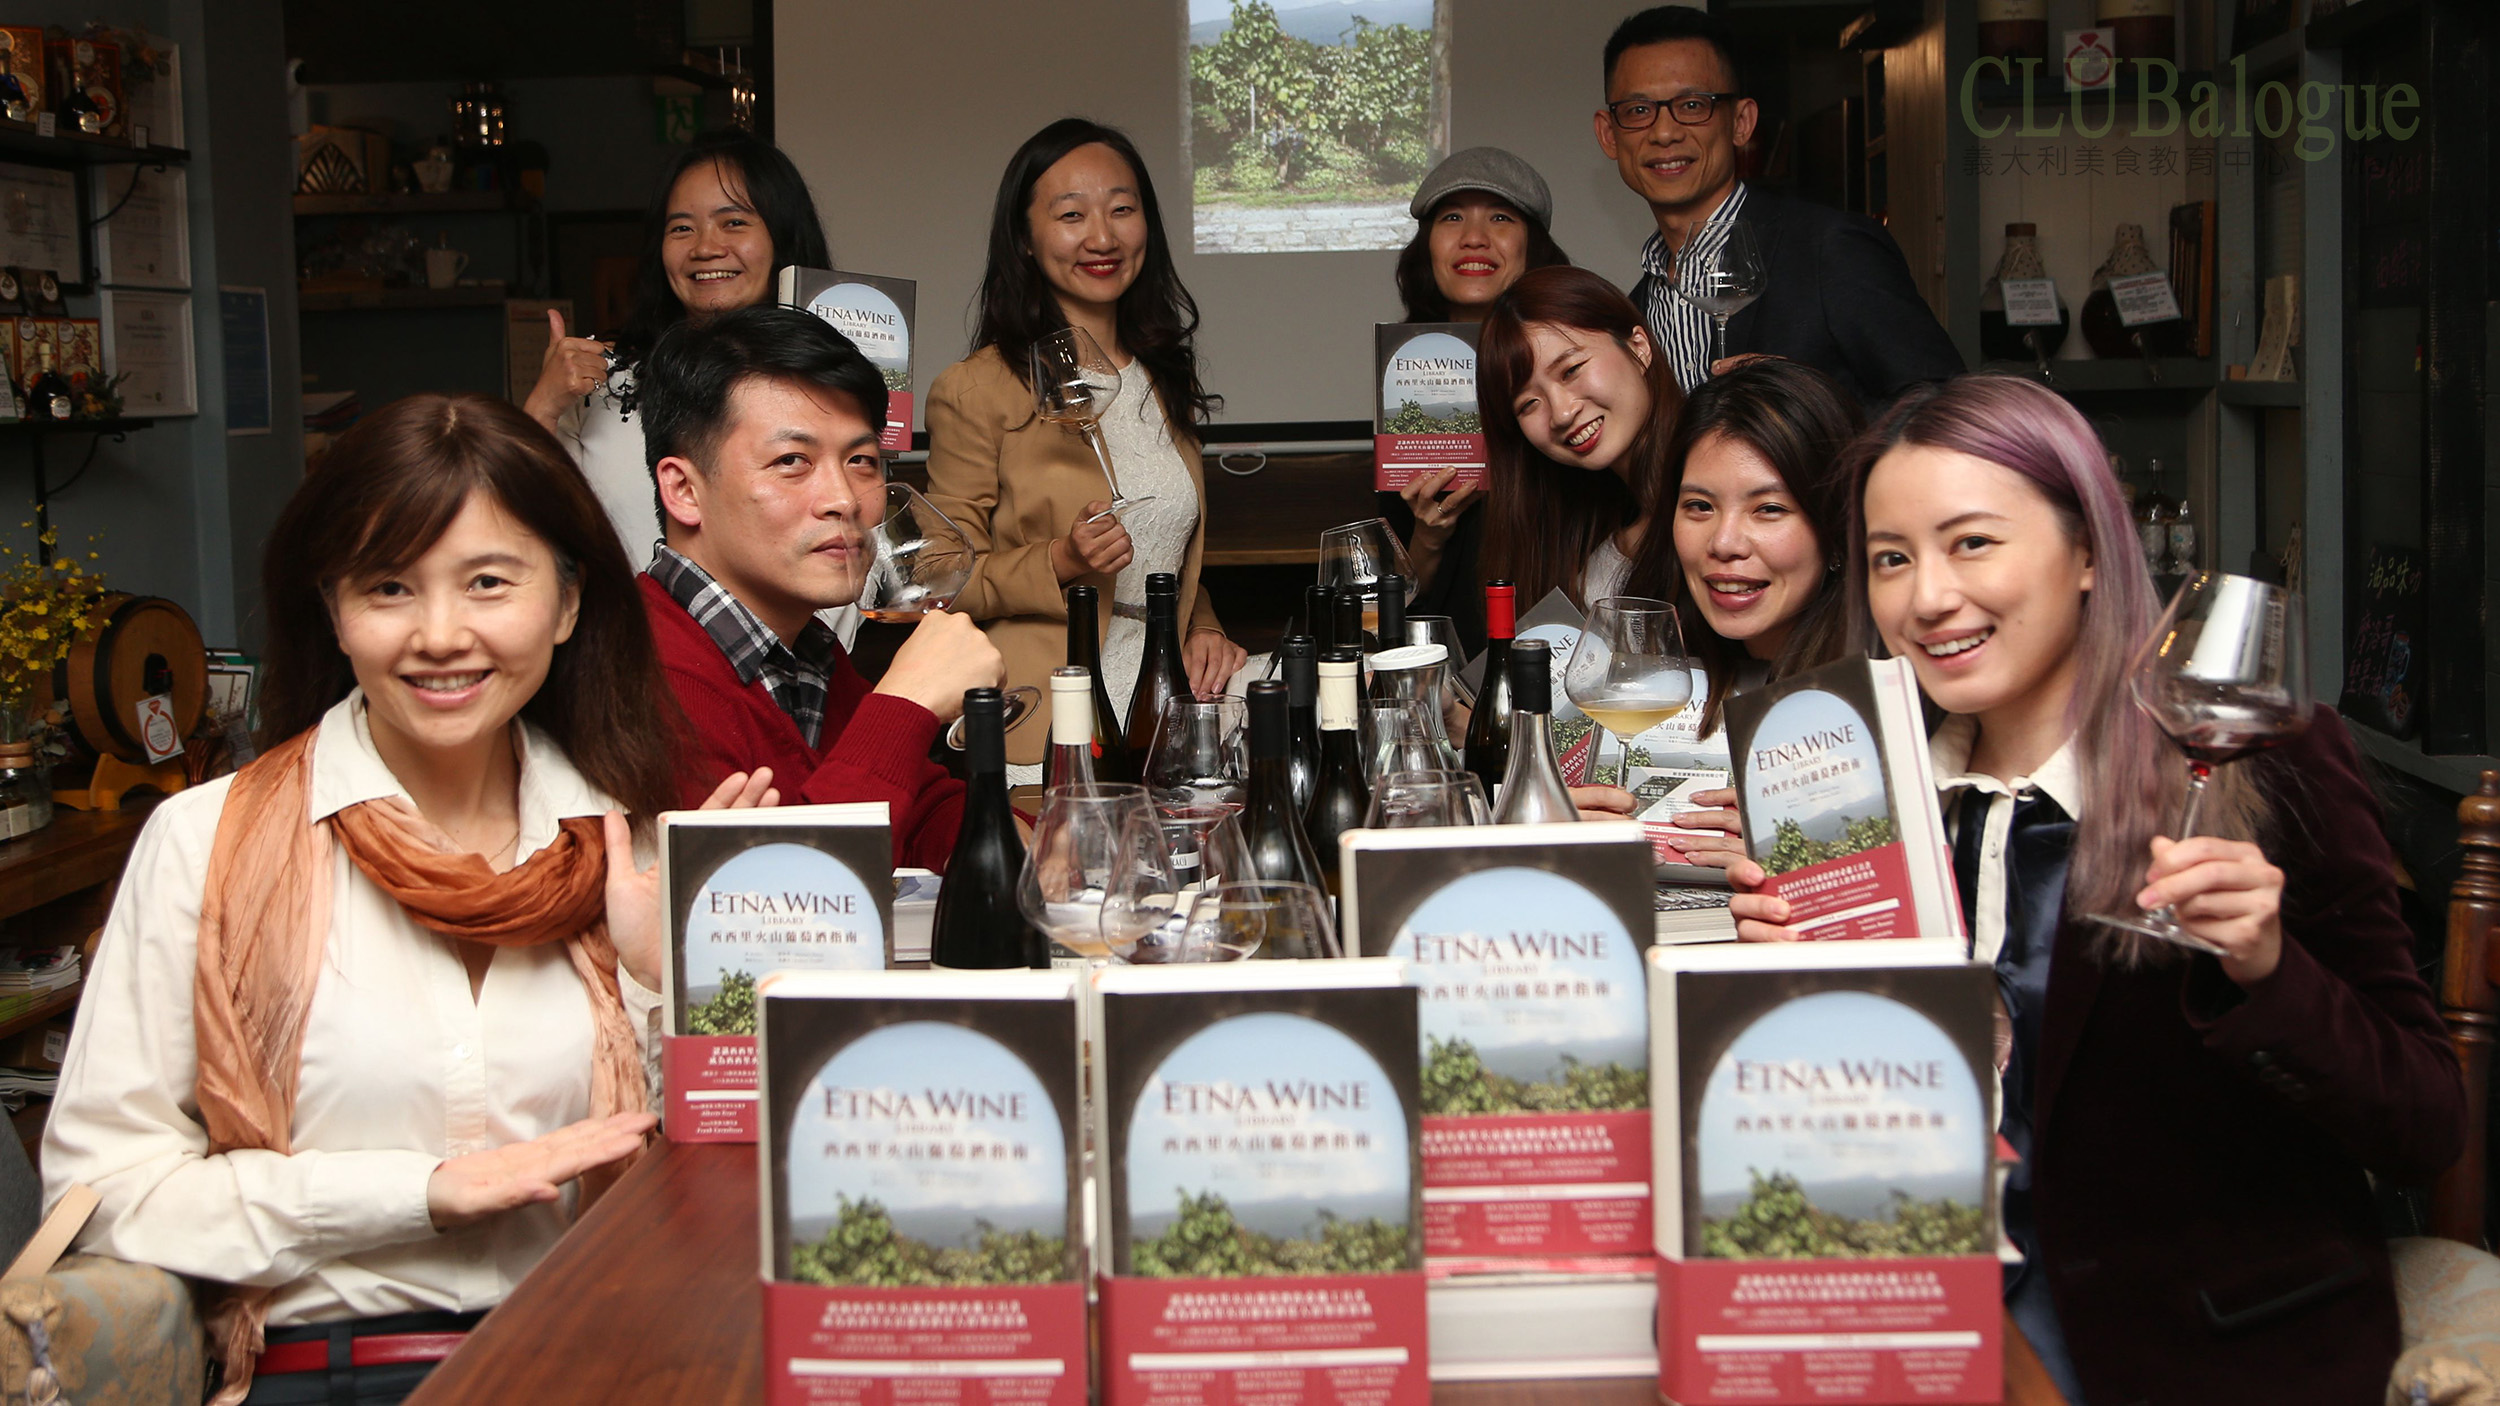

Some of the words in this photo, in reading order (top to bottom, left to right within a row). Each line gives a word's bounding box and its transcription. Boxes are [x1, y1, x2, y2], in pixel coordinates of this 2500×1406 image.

[815, 304, 852, 321] ETNA
[855, 308, 896, 326] WINE
[843, 320, 867, 329] LIBRARY
[838, 328, 895, 342] 火山葡萄酒指南
[1396, 358, 1431, 371] ETNA
[1434, 357, 1473, 370] WINE
[1756, 742, 1803, 771] ETNA
[1803, 724, 1856, 756] WINE
[1793, 757, 1822, 771] LIBRARY
[1762, 758, 1861, 799] 西西里火山葡萄酒指南
[710, 891, 777, 914] ETNA
[783, 891, 857, 914] WINE
[761, 915, 804, 925] LIBRARY
[710, 930, 858, 944] 西西里火山葡萄酒指南
[1413, 933, 1502, 964] ETNA
[1510, 931, 1608, 960] WINE
[1735, 1060, 1830, 1092] ETNA
[1840, 1058, 1945, 1090] WINE
[823, 1087, 917, 1121] ETNA
[923, 1086, 1028, 1120] WINE
[1162, 1081, 1258, 1115] ETNA
[1263, 1078, 1370, 1110] WINE
